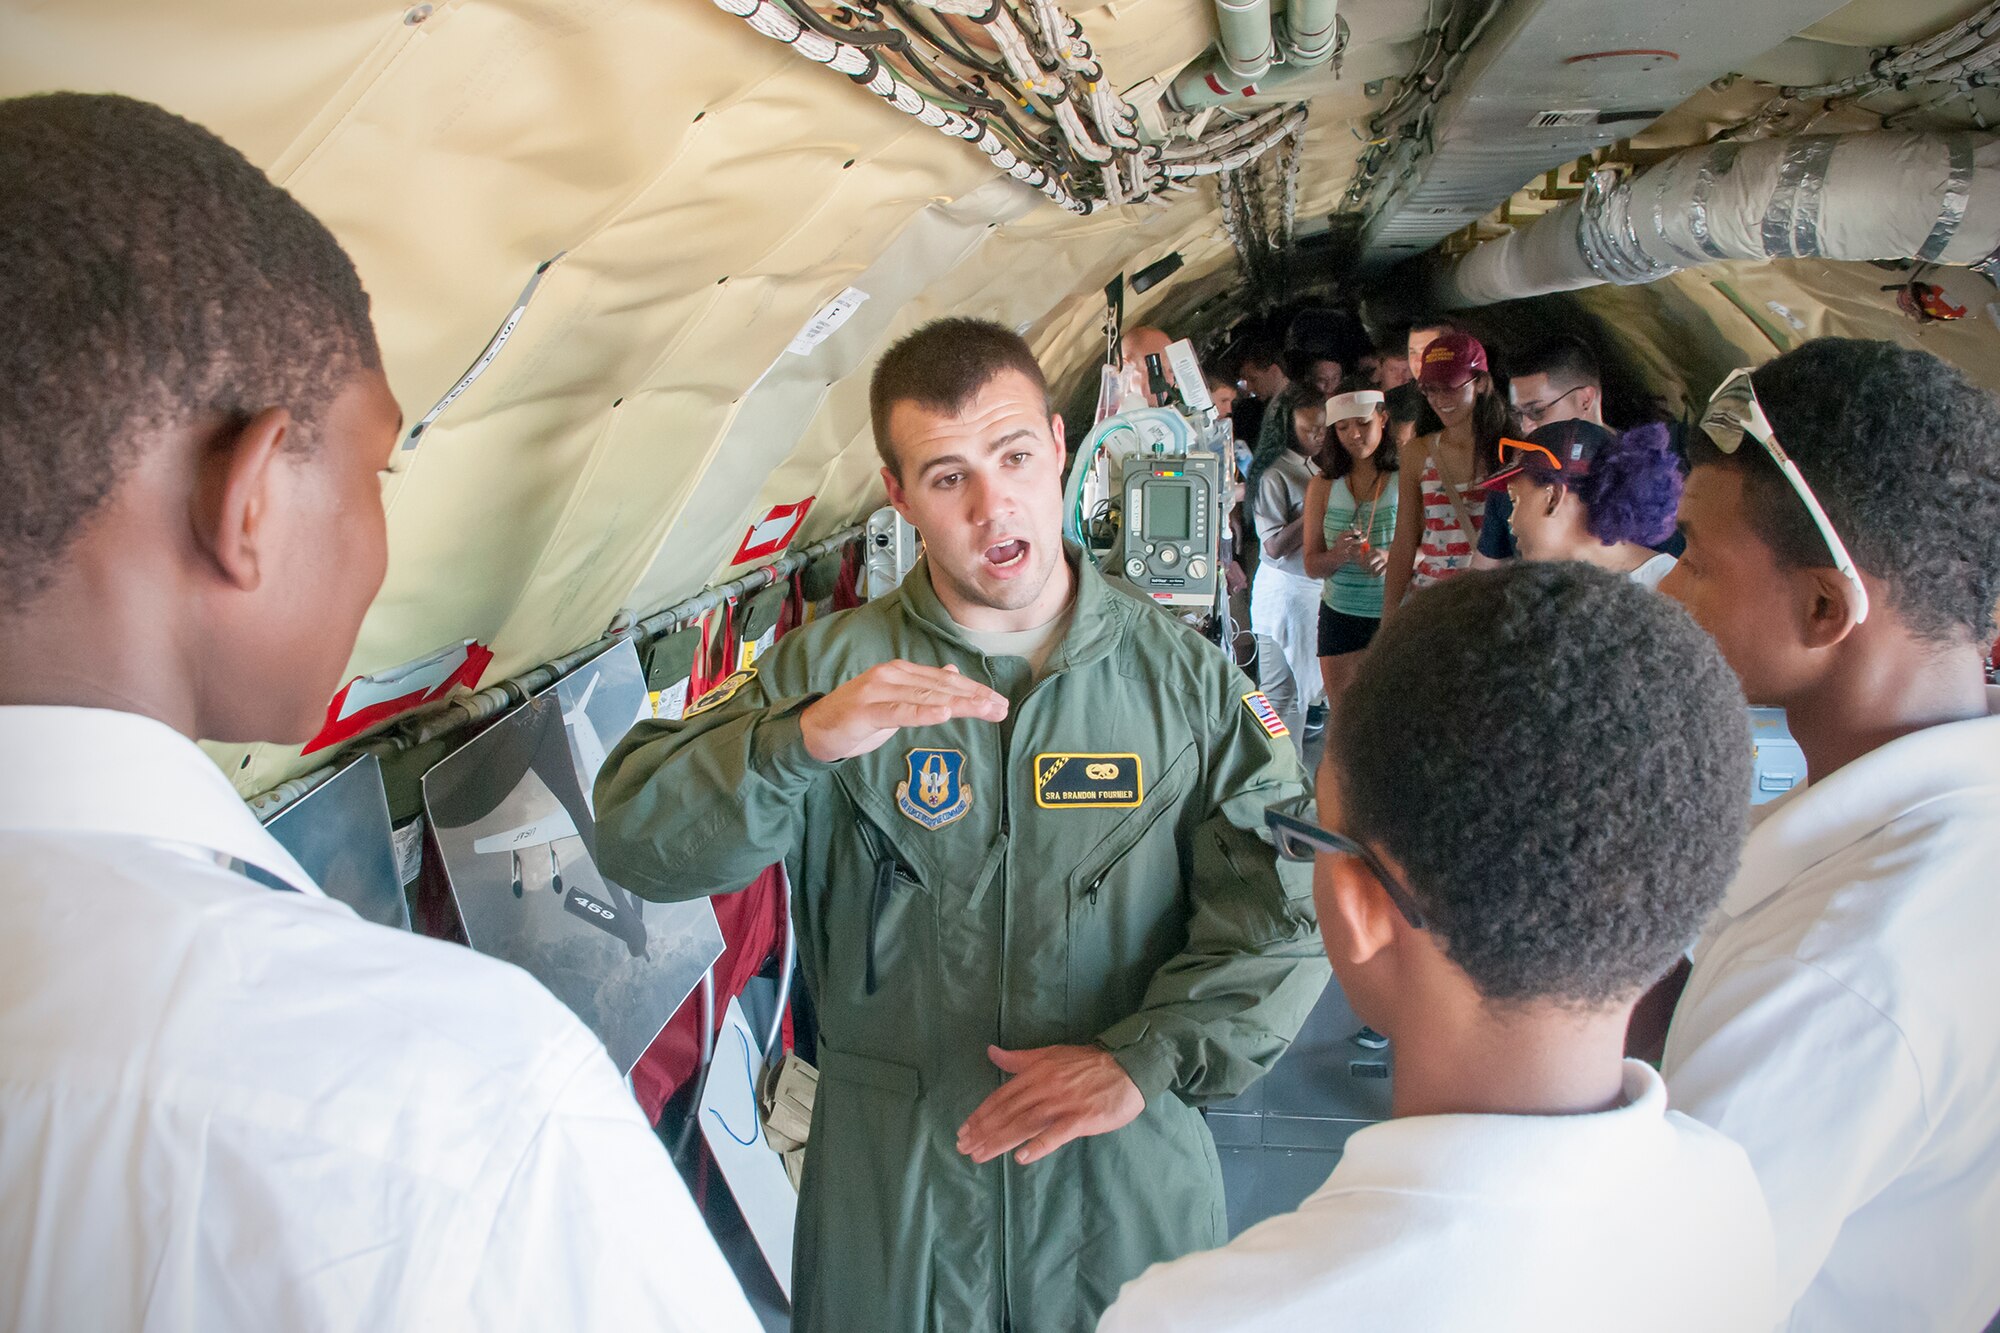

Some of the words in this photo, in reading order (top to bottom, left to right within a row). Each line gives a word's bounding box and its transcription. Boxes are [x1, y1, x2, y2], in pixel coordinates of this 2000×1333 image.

[827, 308, 840, 320] F
[1045, 791, 1060, 800] SRA
[1062, 791, 1096, 800] BRANDON
[1098, 790, 1133, 799] FOURNIER
[574, 897, 615, 920] 459
